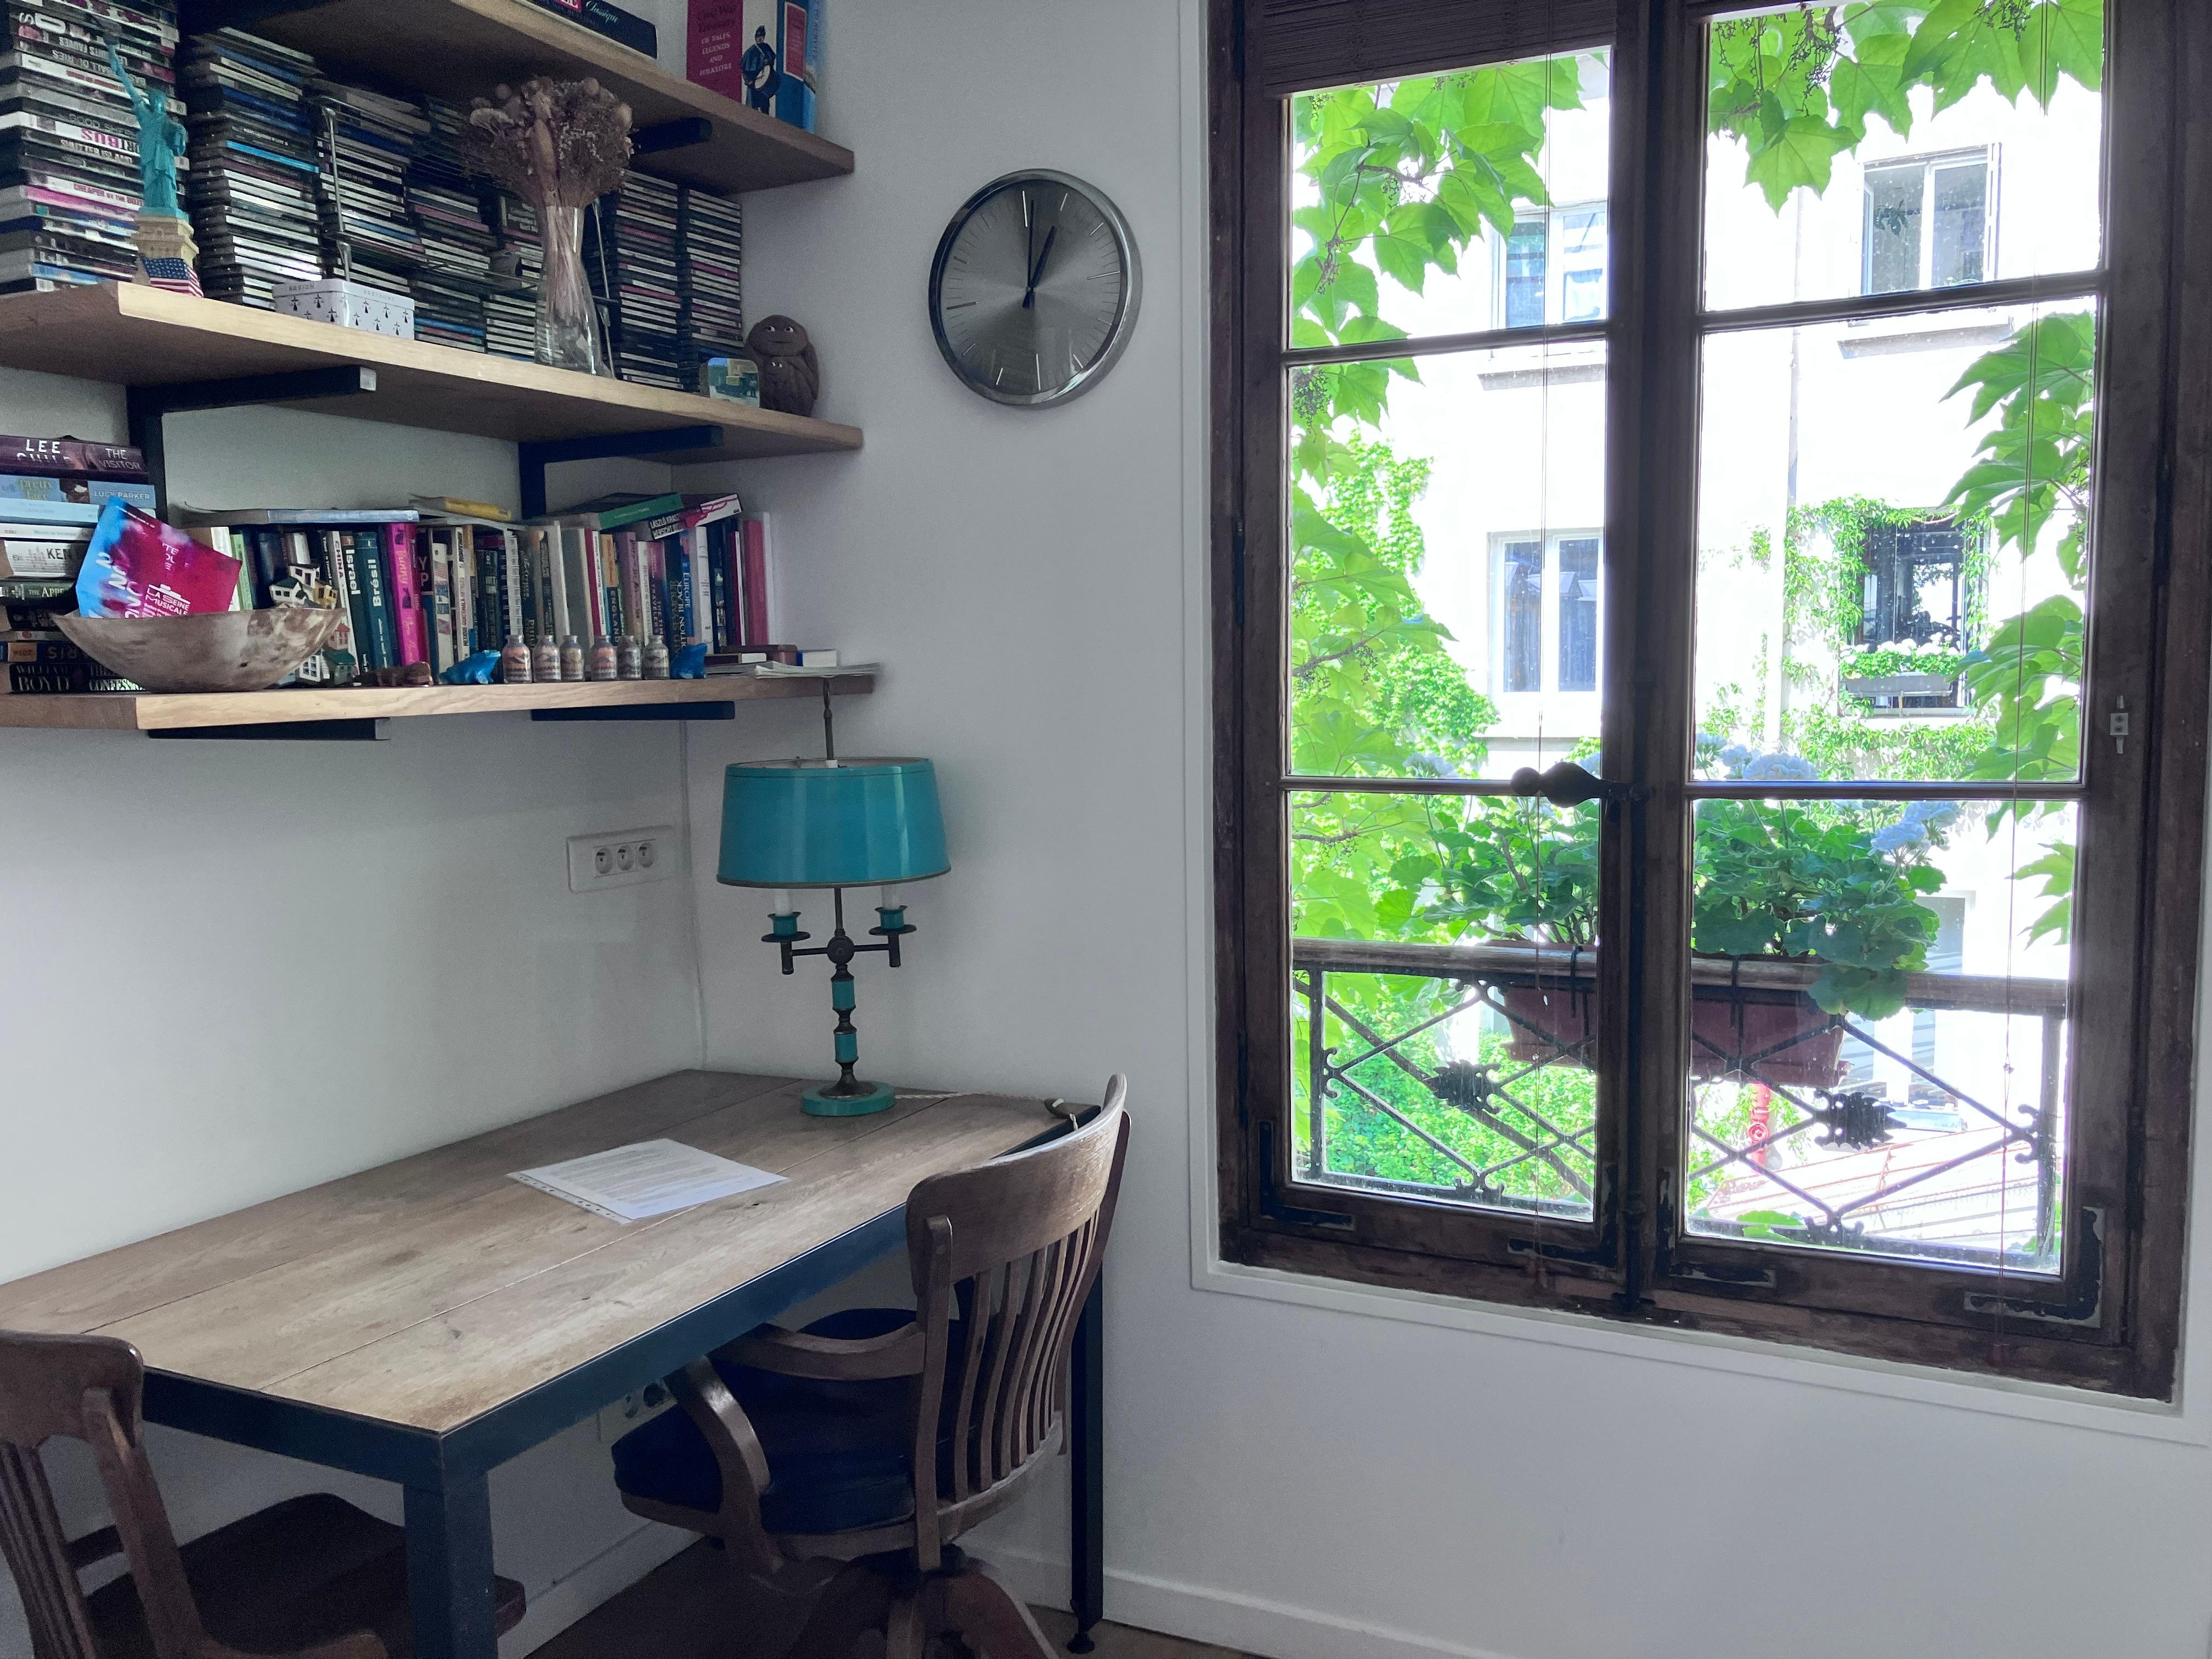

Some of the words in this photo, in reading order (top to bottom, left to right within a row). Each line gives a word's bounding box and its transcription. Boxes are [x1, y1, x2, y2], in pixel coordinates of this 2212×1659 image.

[702, 42, 730, 55] LEGENDS
[708, 54, 723, 64] AND
[699, 62, 732, 76] FOLKLORE
[364, 290, 395, 301] BRETAGNE
[26, 439, 61, 455] LEE
[105, 448, 127, 460] THE
[99, 459, 141, 471] VISITOR
[117, 491, 150, 501] PARKER
[334, 540, 344, 579] CHINA
[346, 548, 360, 595] Israel
[368, 558, 383, 607] Brésil
[146, 588, 161, 599] LA
[162, 594, 189, 611] SEINE
[670, 580, 679, 630] SEYMOUR
[611, 590, 619, 643] ENGLAND
[19, 675, 69, 692] BOYD
